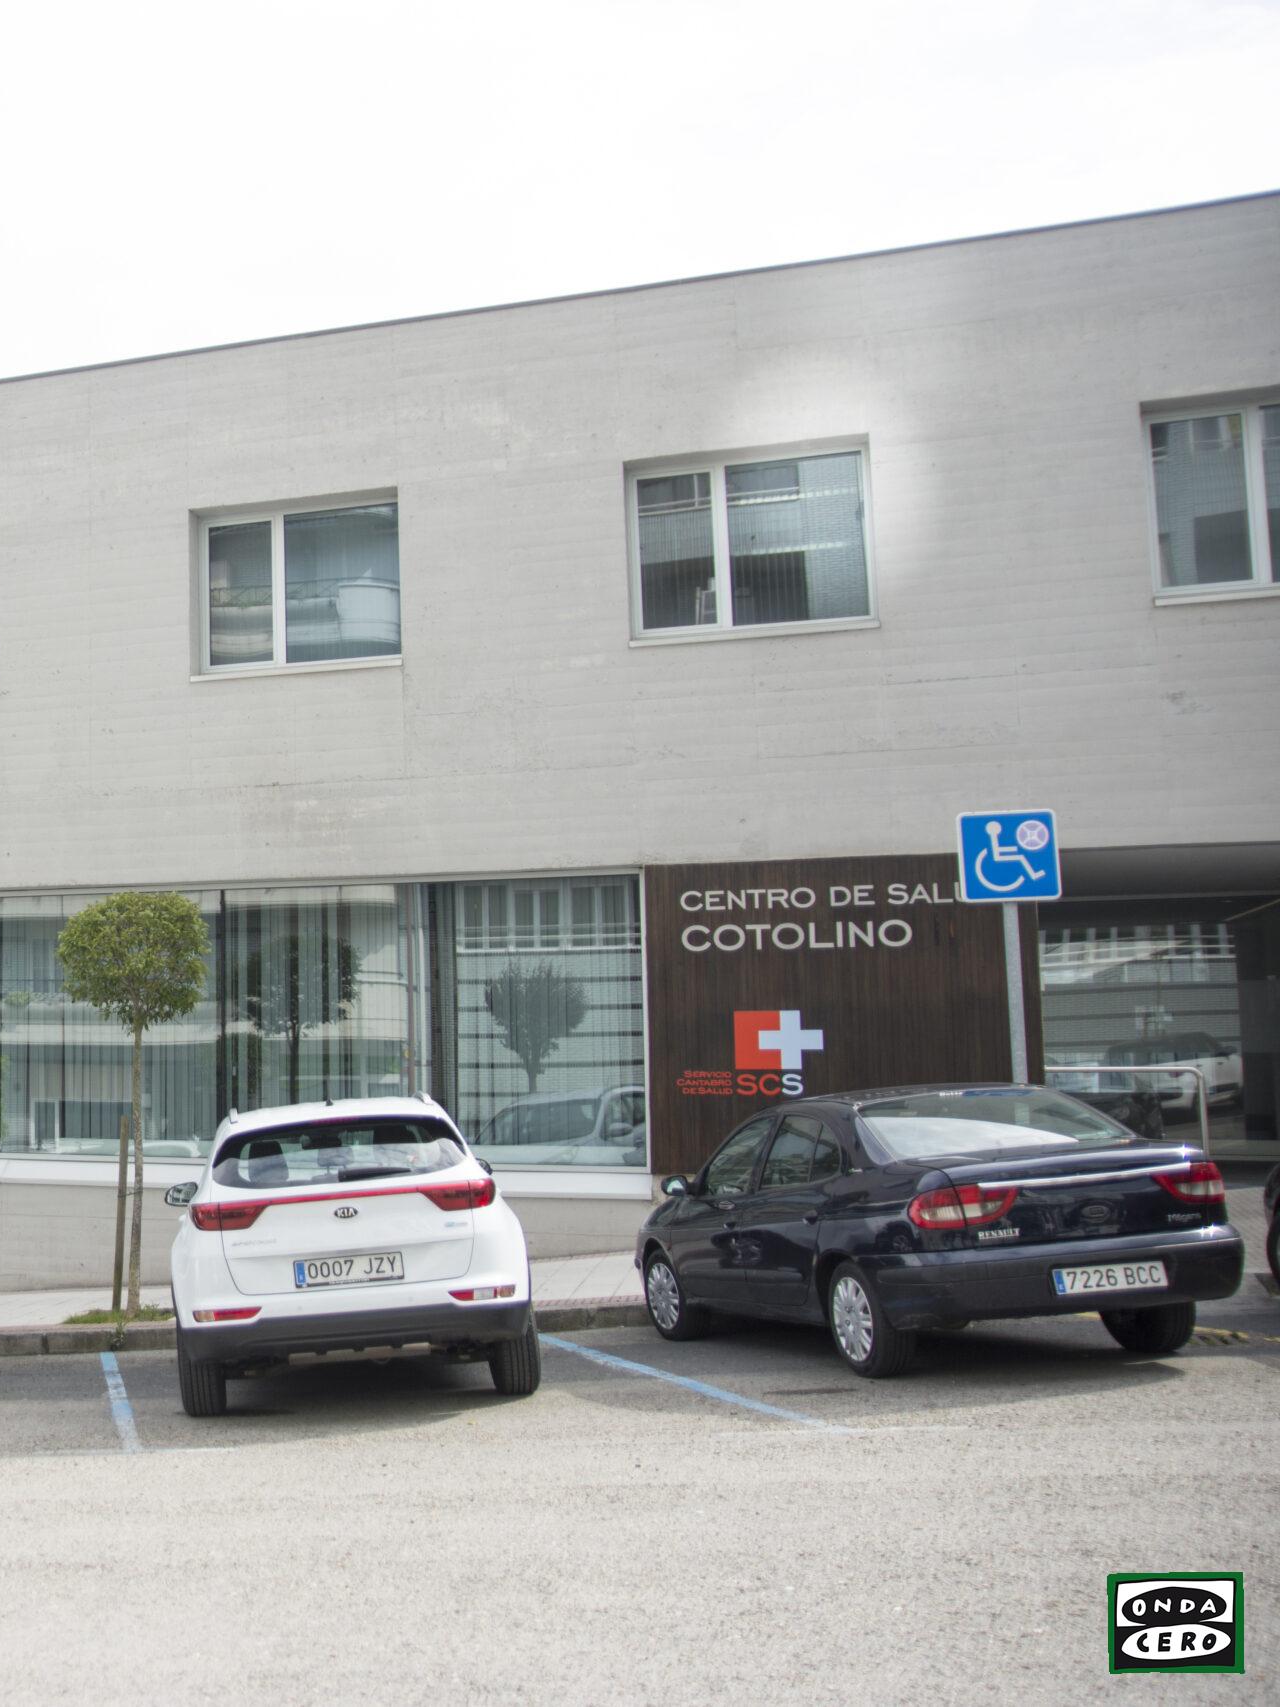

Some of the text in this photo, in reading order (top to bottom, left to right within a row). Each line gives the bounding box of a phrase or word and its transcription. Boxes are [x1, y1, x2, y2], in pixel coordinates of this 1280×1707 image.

[680, 887, 816, 911] CENTRO
[829, 885, 875, 907] DE
[681, 919, 913, 952] COTOLINO
[736, 1073, 804, 1096] SCS
[335, 1207, 357, 1218] KIA
[978, 1228, 1020, 1240] RENAULT
[308, 1255, 396, 1279] 0007 JZY
[1066, 1265, 1161, 1290] 7226 BCC
